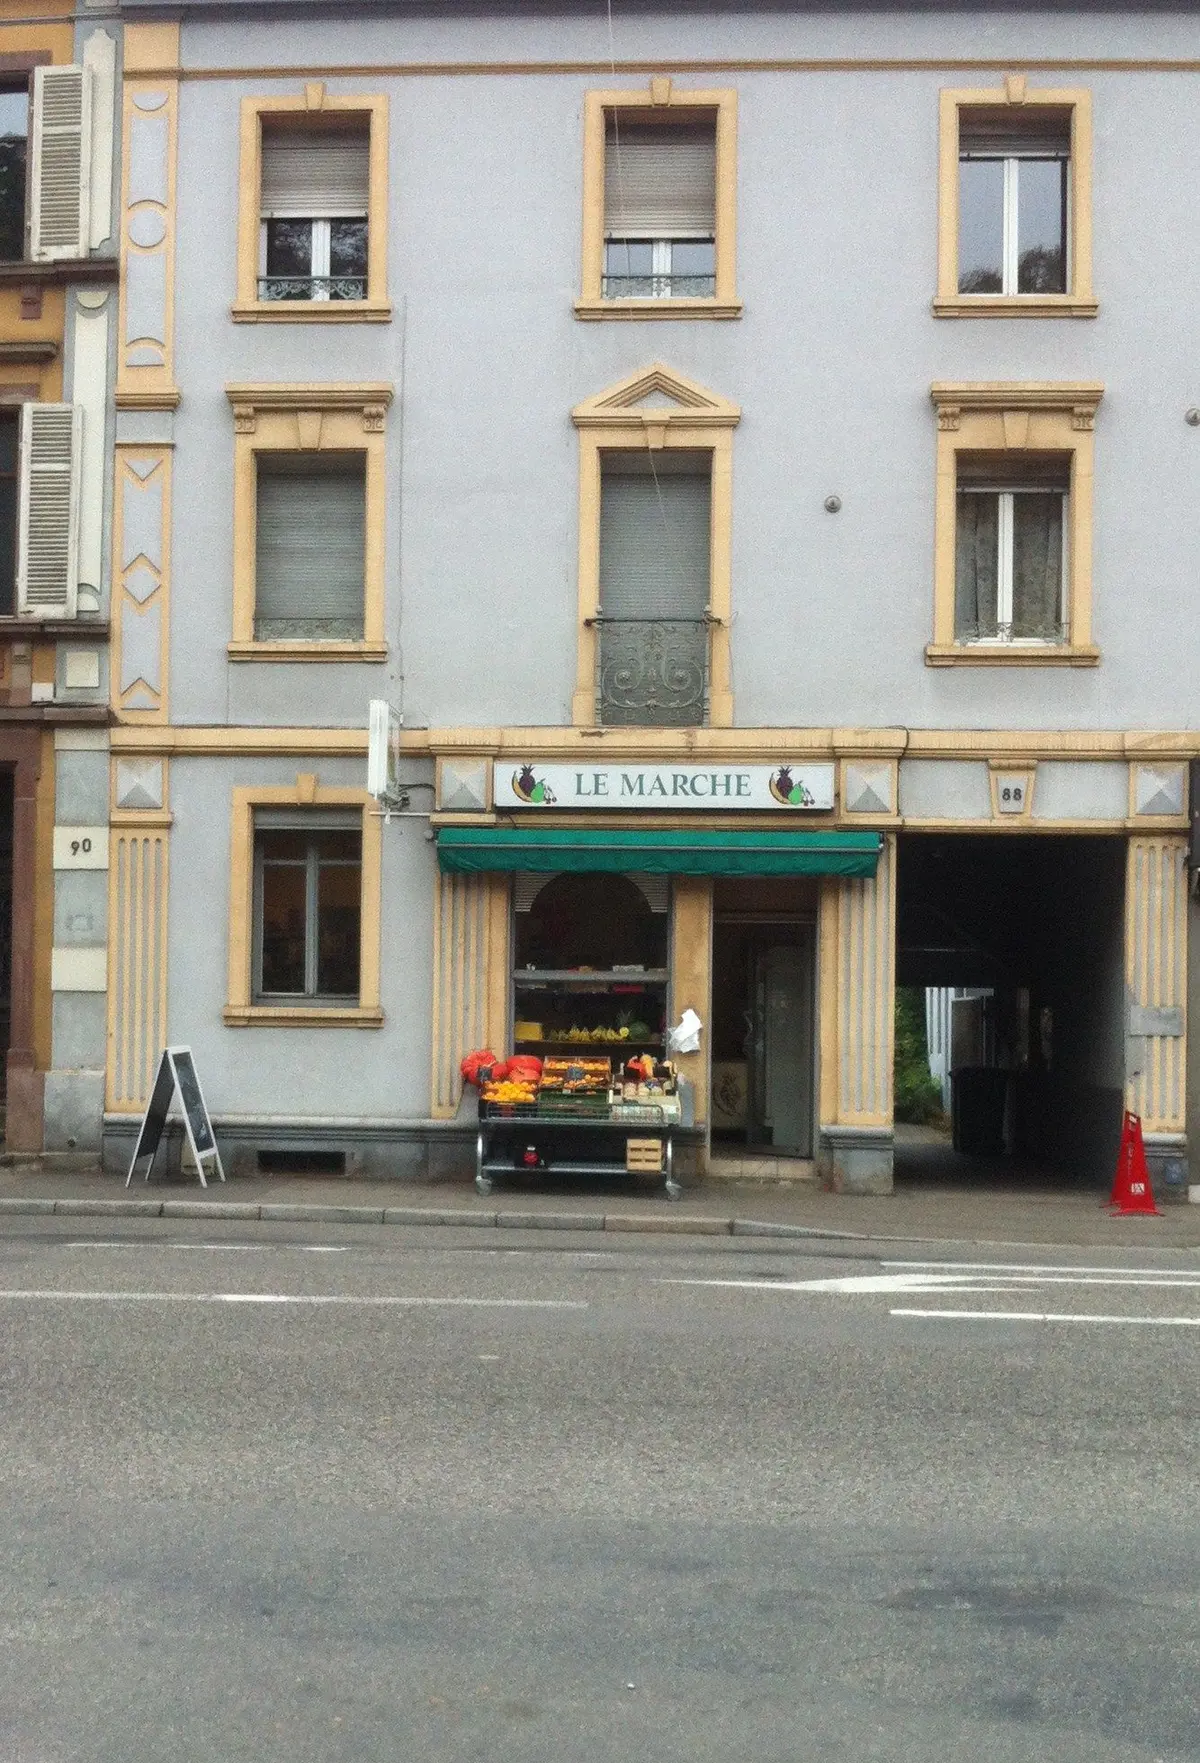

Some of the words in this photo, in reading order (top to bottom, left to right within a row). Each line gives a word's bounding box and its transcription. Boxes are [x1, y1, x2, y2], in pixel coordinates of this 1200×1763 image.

[575, 773, 609, 796] LE
[620, 773, 752, 797] MARCHE
[1002, 787, 1022, 801] 88
[70, 837, 92, 857] 90
